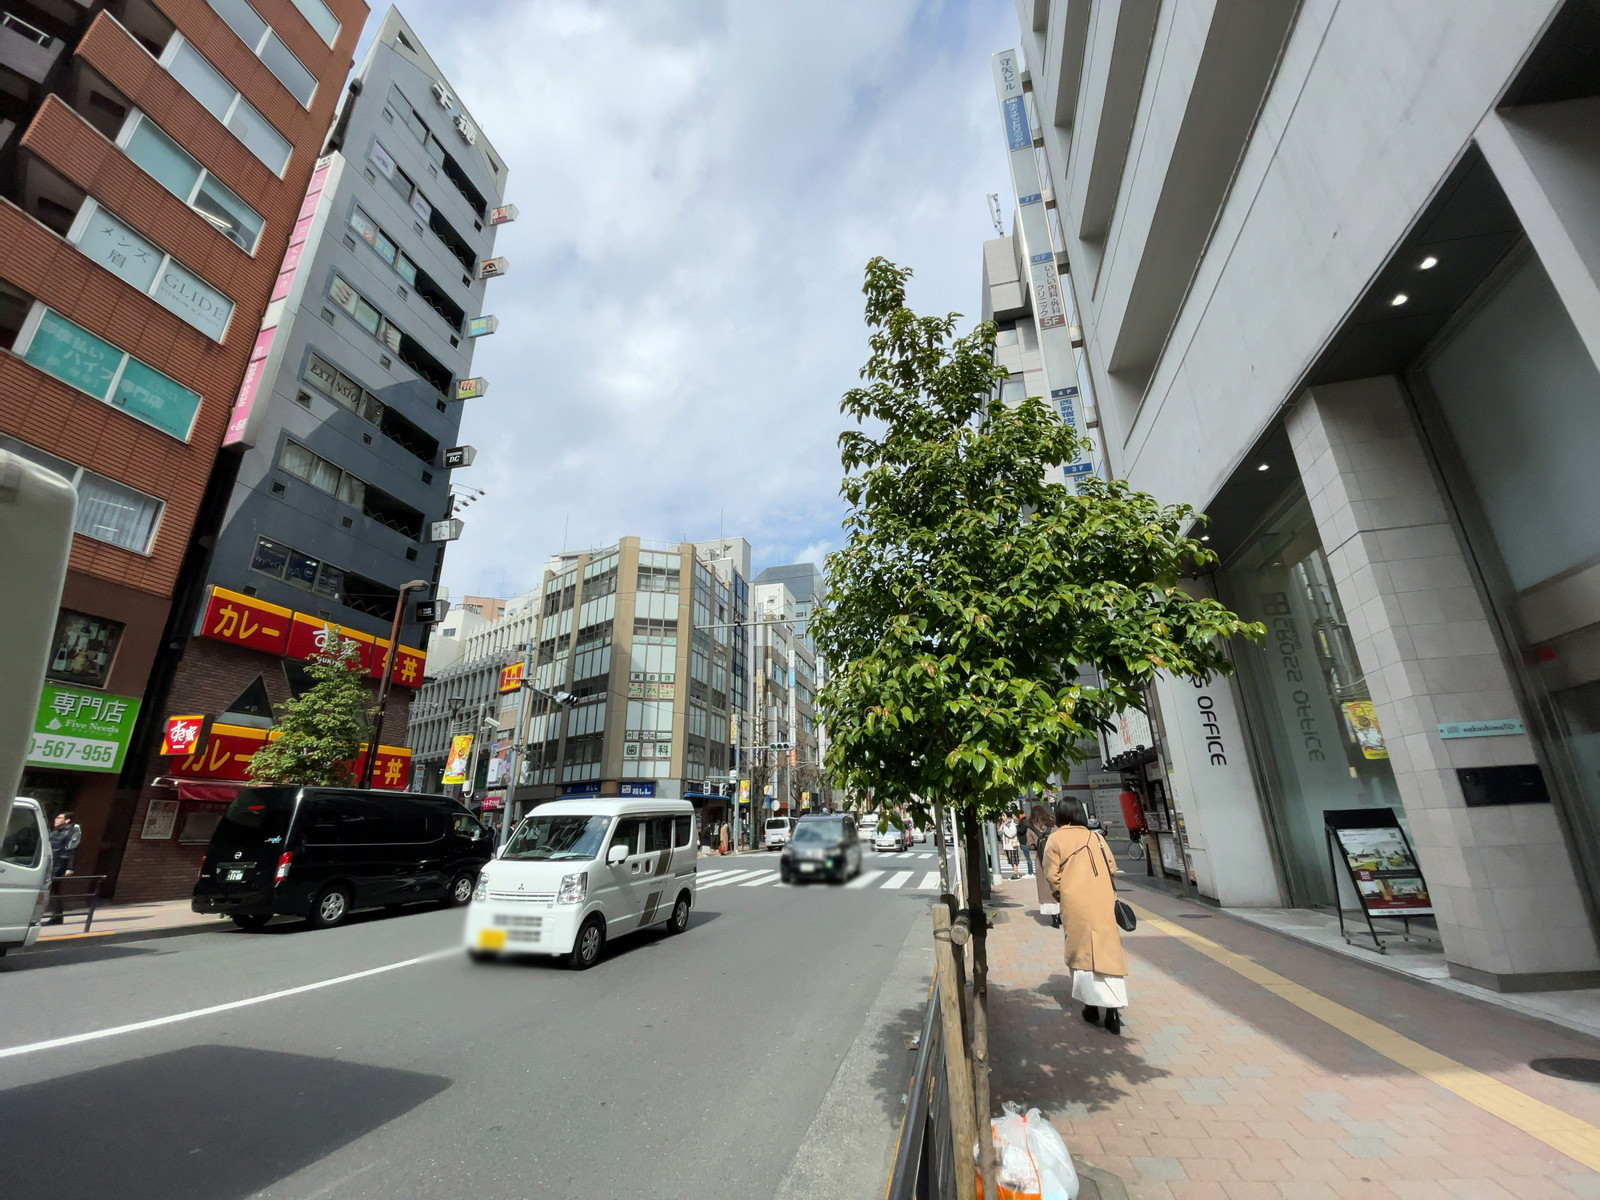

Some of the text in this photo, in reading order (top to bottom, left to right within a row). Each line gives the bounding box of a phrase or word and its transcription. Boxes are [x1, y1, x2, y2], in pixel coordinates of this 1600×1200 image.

[101, 227, 152, 264] メンズ
[107, 249, 127, 269] 眉
[164, 273, 224, 321] GLIDE
[1036, 284, 1049, 317] クリニック
[1044, 317, 1061, 327] 5F
[213, 604, 280, 640] カレー
[49, 692, 128, 724] 専門店
[65, 719, 119, 734] Five Needs
[1197, 695, 1227, 767] OFFICE
